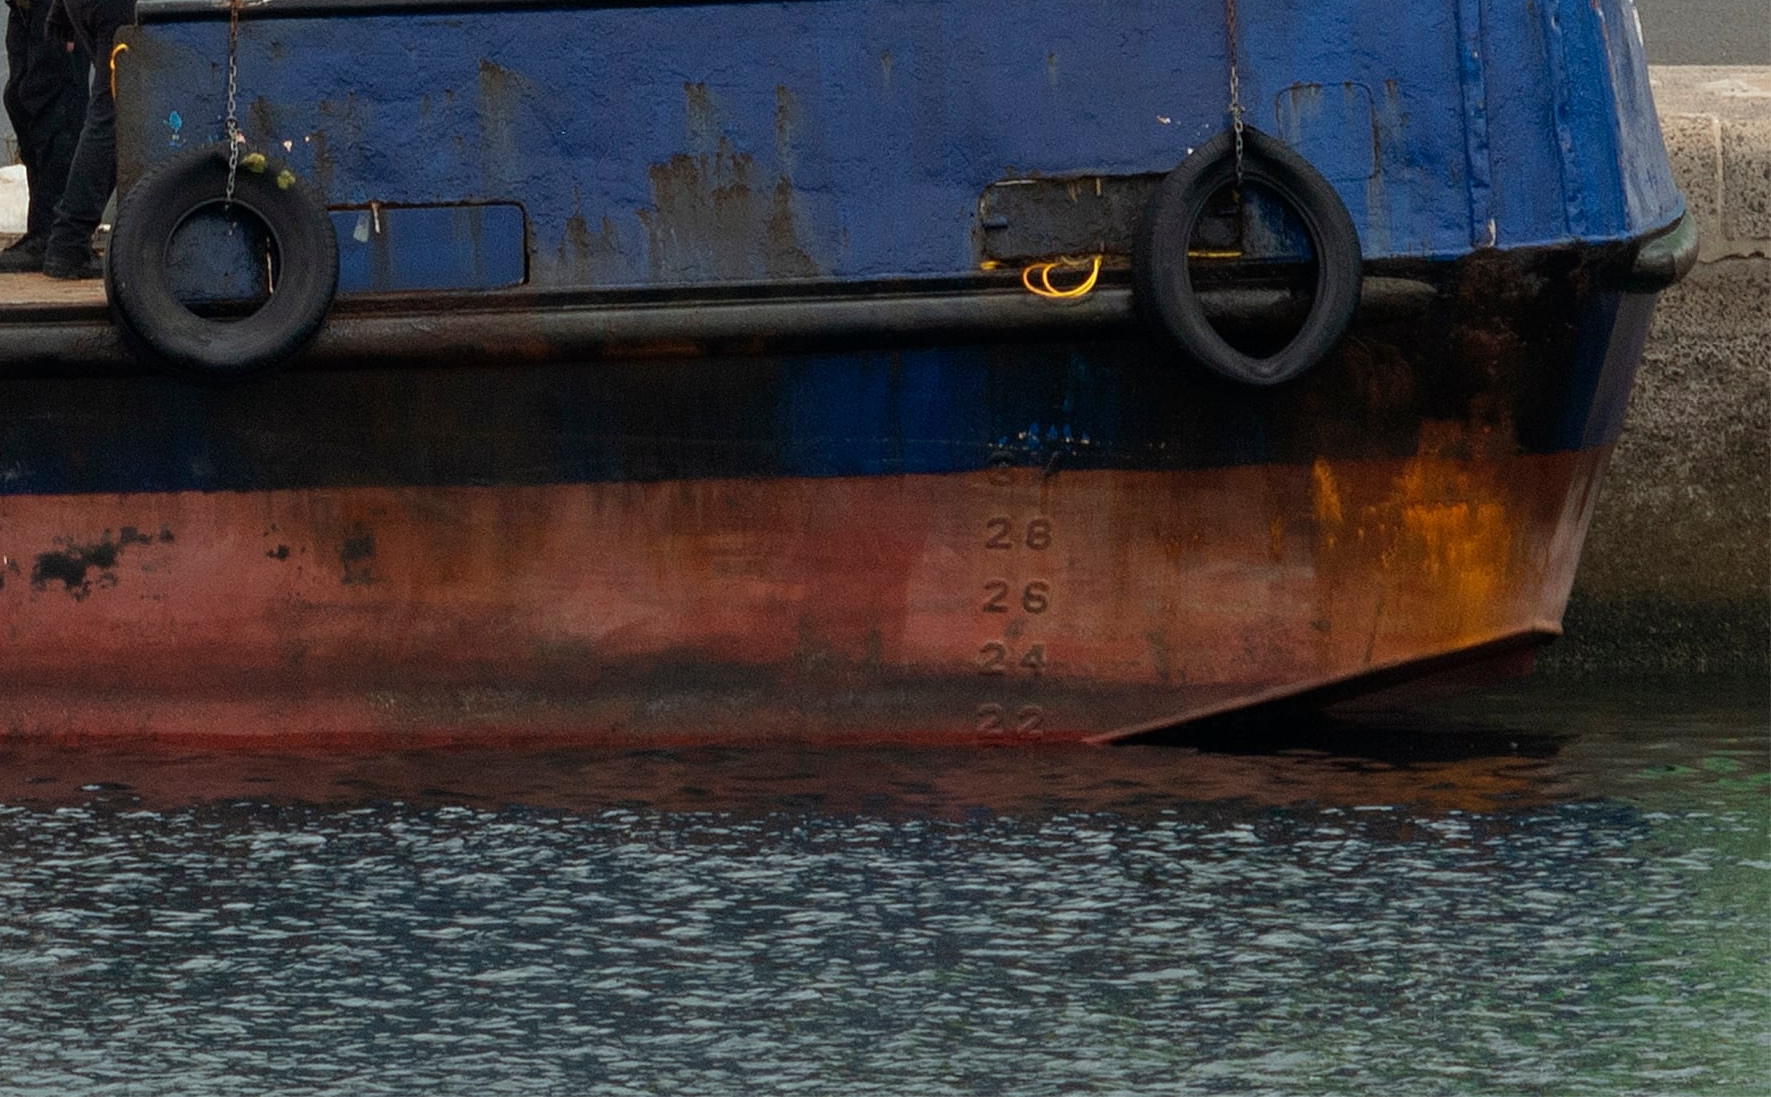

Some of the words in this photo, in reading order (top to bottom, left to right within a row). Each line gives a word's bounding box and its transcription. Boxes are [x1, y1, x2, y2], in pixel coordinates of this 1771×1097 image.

[984, 516, 1052, 551] 28
[982, 579, 1049, 614] 26
[978, 642, 1047, 677] 24
[976, 703, 1044, 735] 22
